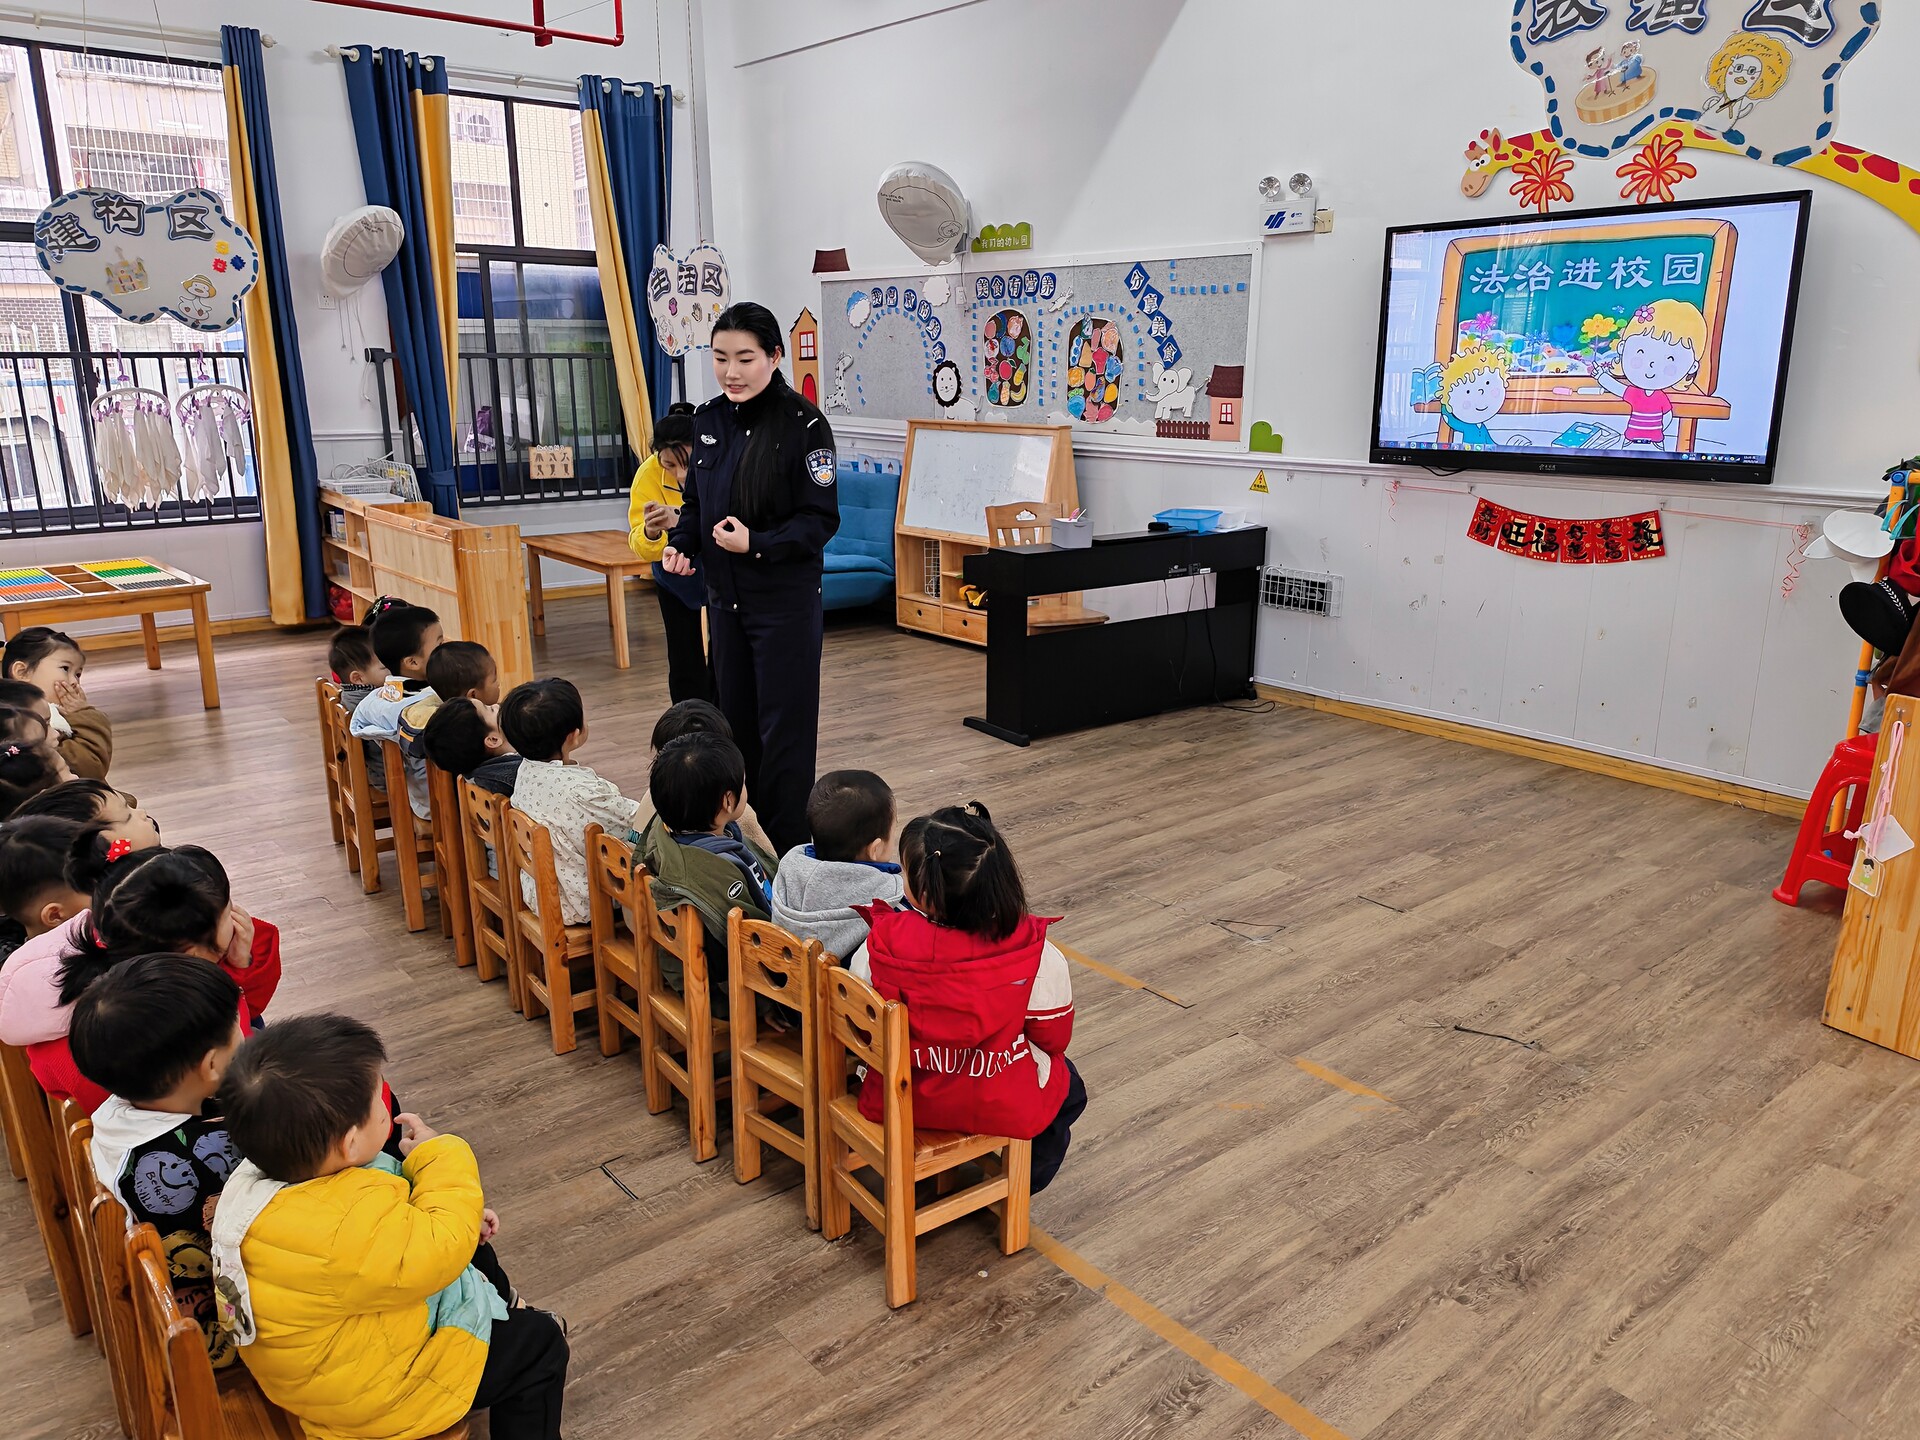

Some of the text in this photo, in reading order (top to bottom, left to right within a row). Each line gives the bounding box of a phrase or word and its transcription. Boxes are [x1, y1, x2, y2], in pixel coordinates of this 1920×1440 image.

[37, 195, 215, 261] 建构区
[650, 263, 722, 300] 生活区
[977, 272, 1055, 298] 美食有营养
[1469, 252, 1704, 295] 法治进校园
[1128, 269, 1178, 364] 分享美食
